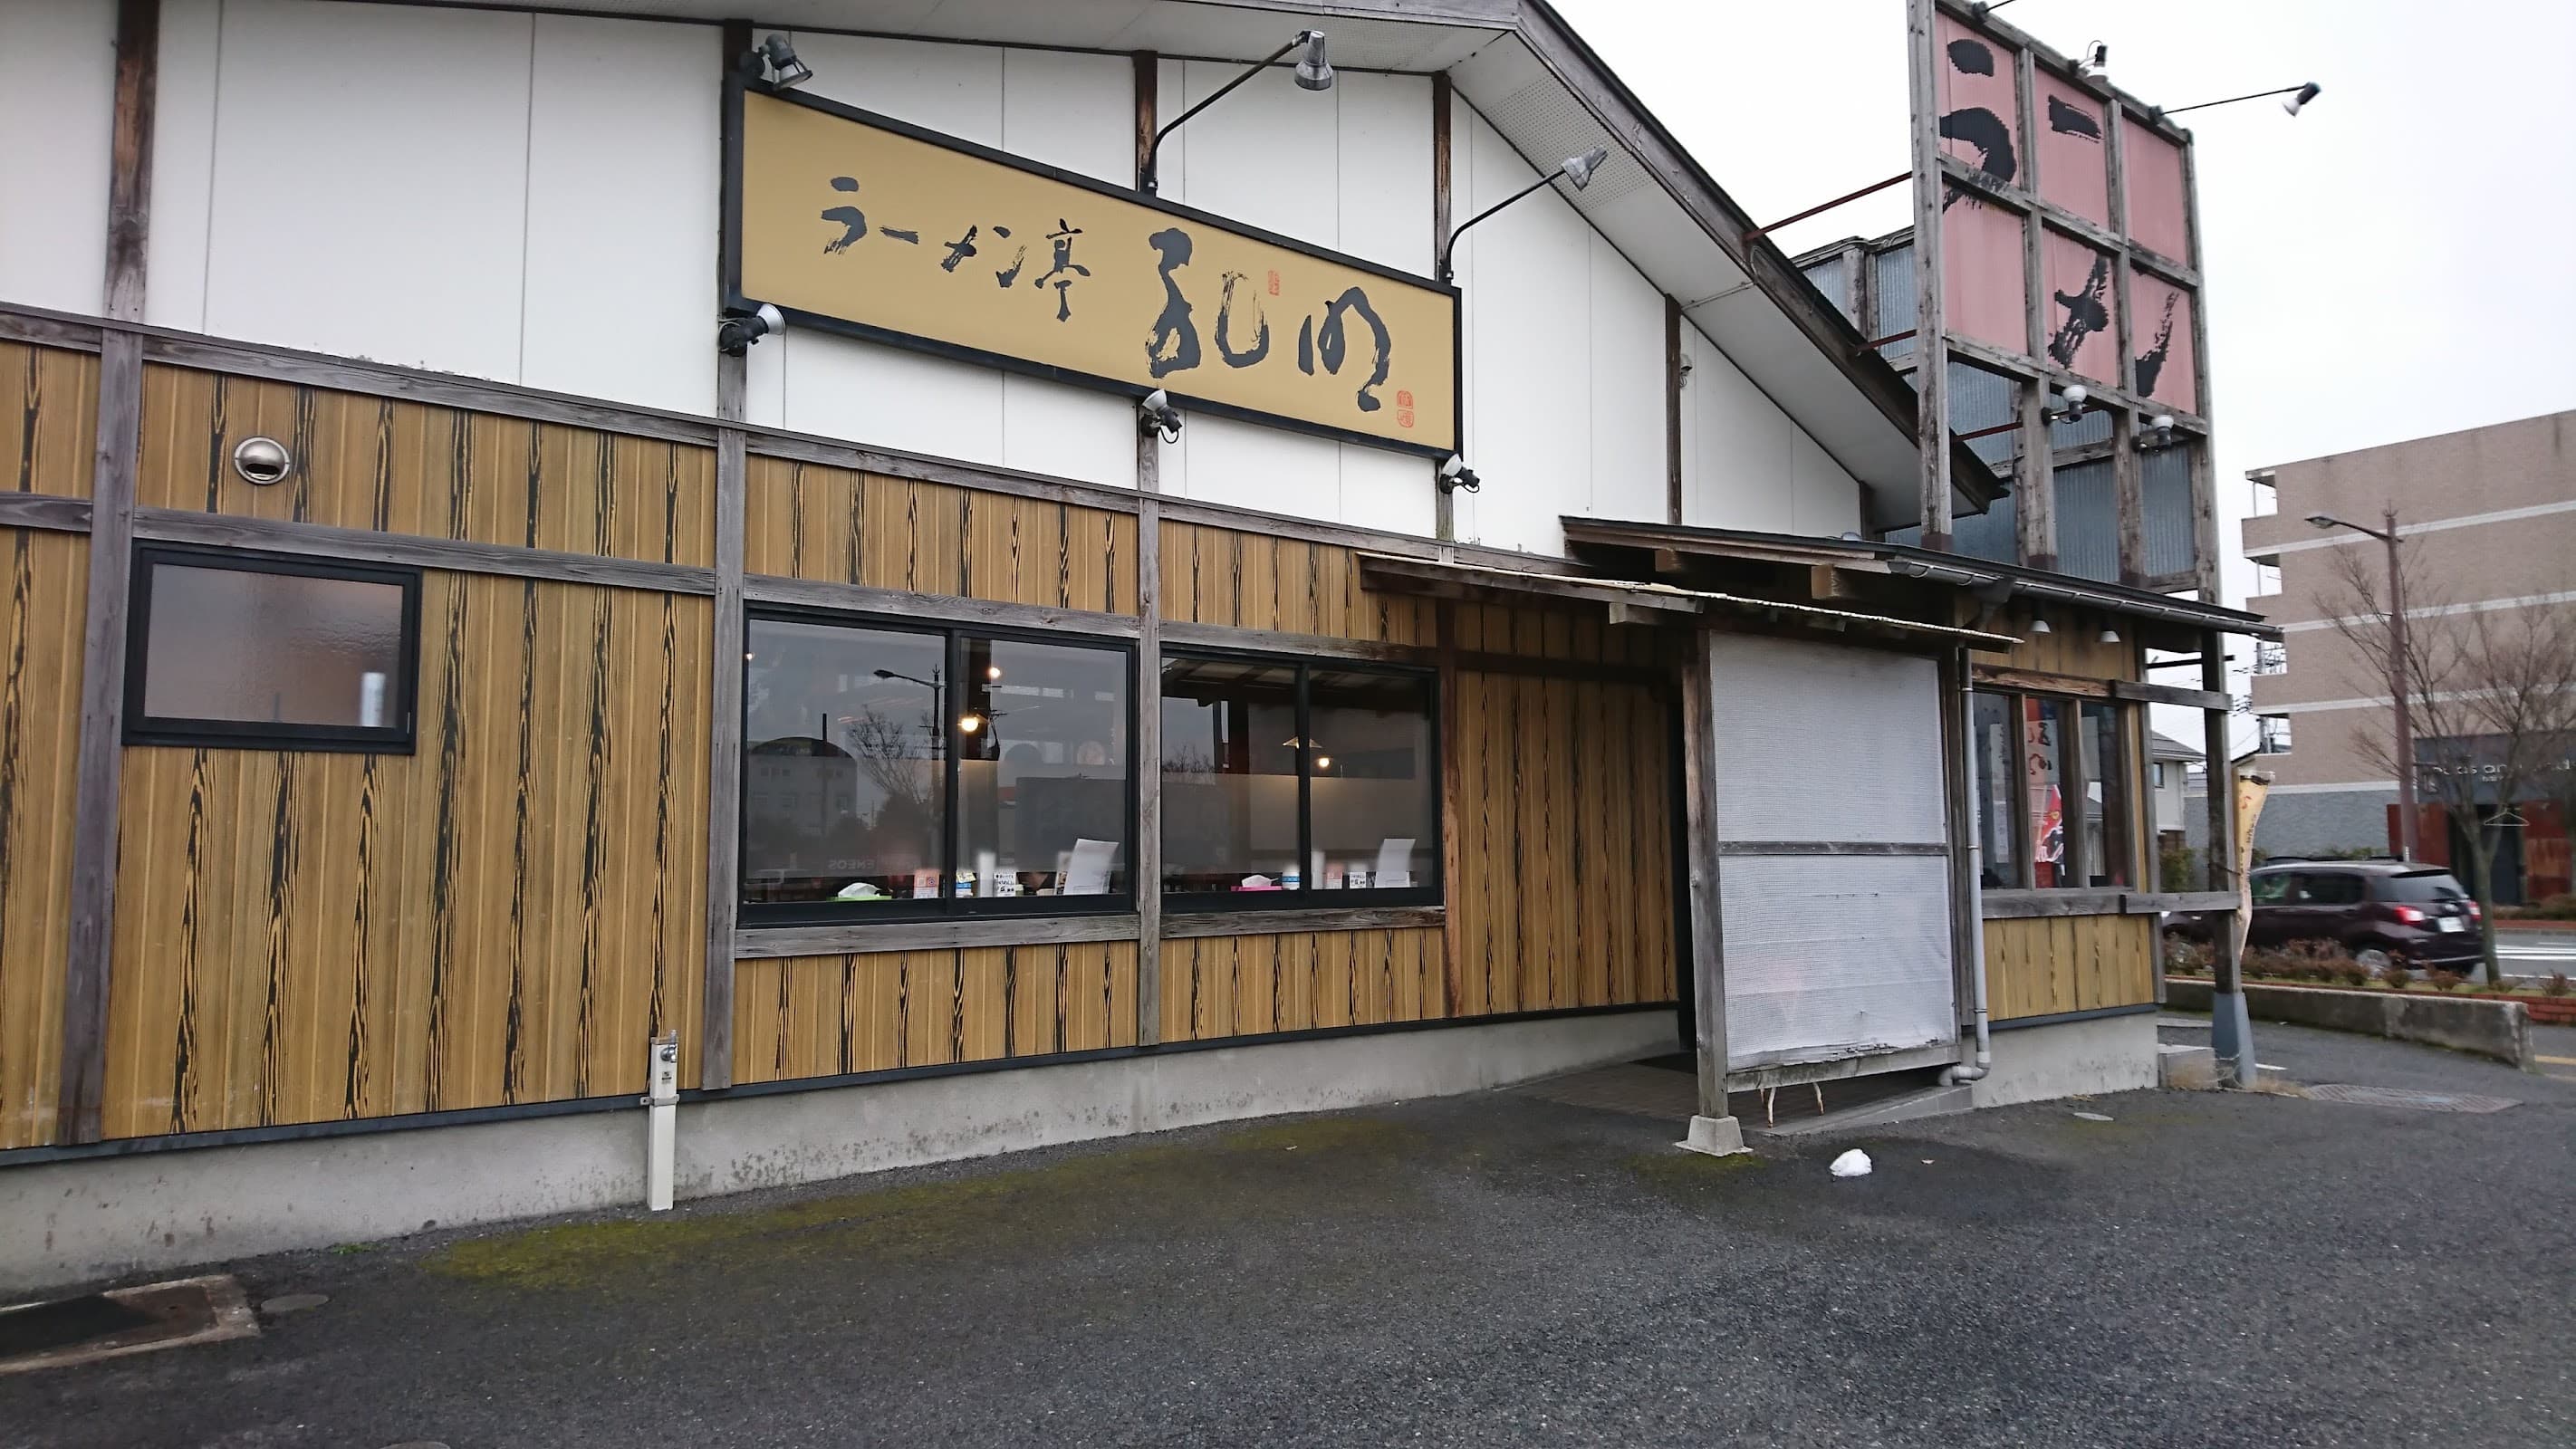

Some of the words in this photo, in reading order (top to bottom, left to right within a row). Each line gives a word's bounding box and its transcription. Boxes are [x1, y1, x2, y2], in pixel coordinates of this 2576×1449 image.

[821, 176, 1091, 322] ラーメン亭
